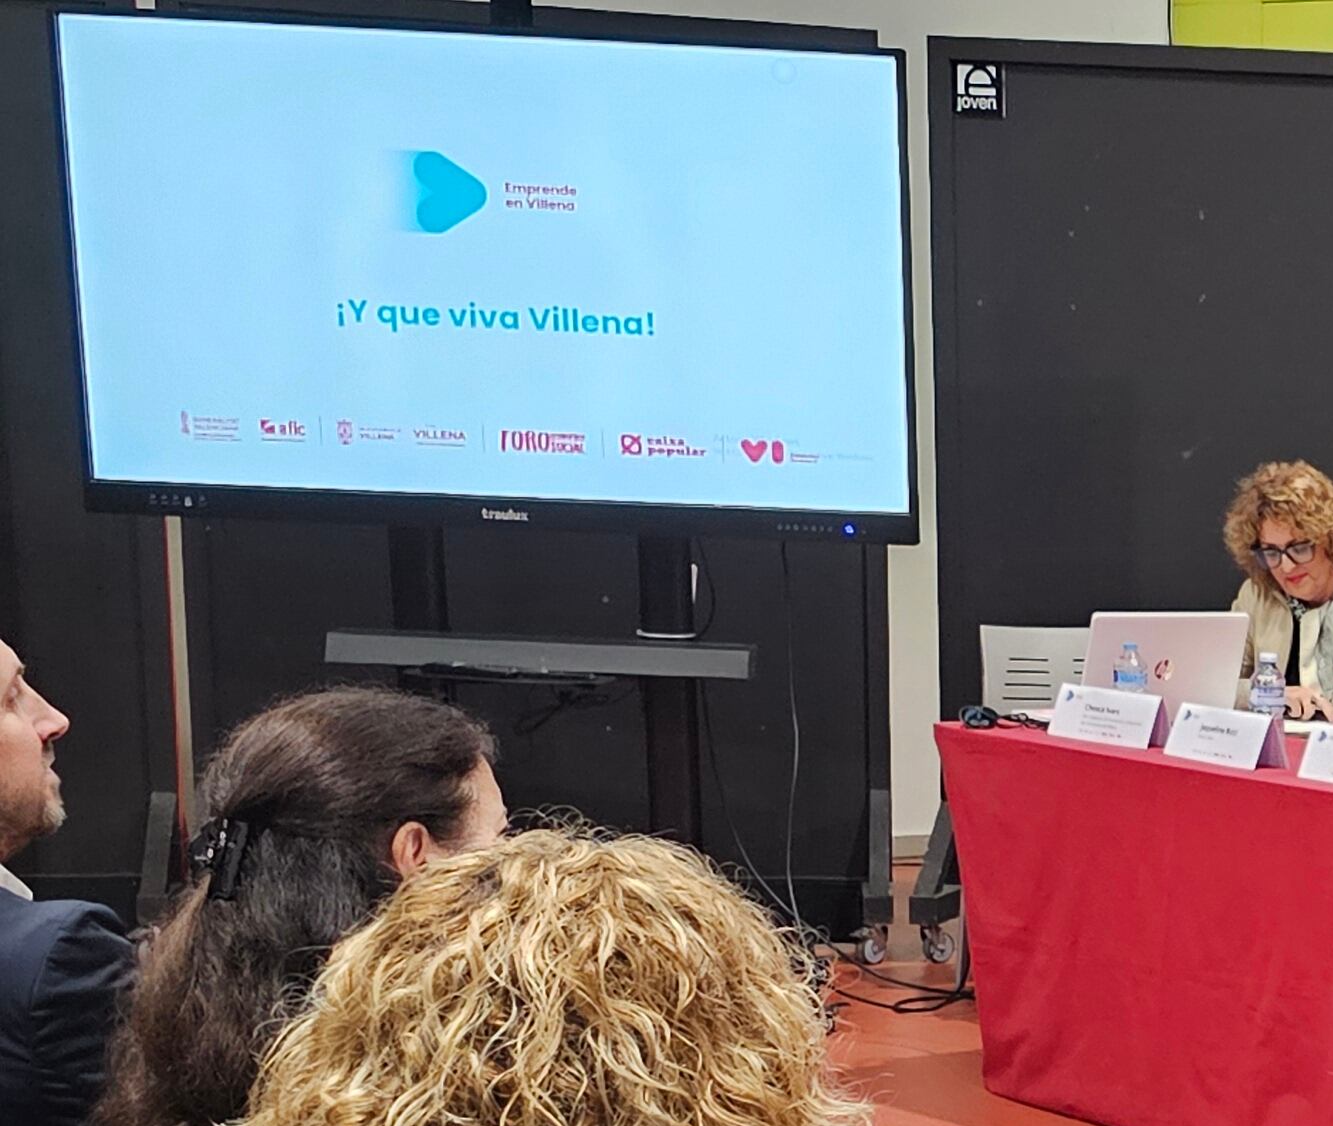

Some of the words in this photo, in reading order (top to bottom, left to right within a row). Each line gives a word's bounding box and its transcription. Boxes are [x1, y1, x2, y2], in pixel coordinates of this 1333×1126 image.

[957, 96, 998, 112] joven
[504, 182, 577, 197] Emprende
[505, 199, 523, 209] en
[526, 198, 575, 211] Villena
[337, 300, 367, 327] ¡Y
[377, 305, 440, 332] que
[448, 302, 520, 329] viva
[528, 306, 655, 336] Villena!
[413, 429, 466, 441] VILLENA
[647, 445, 706, 458] popular
